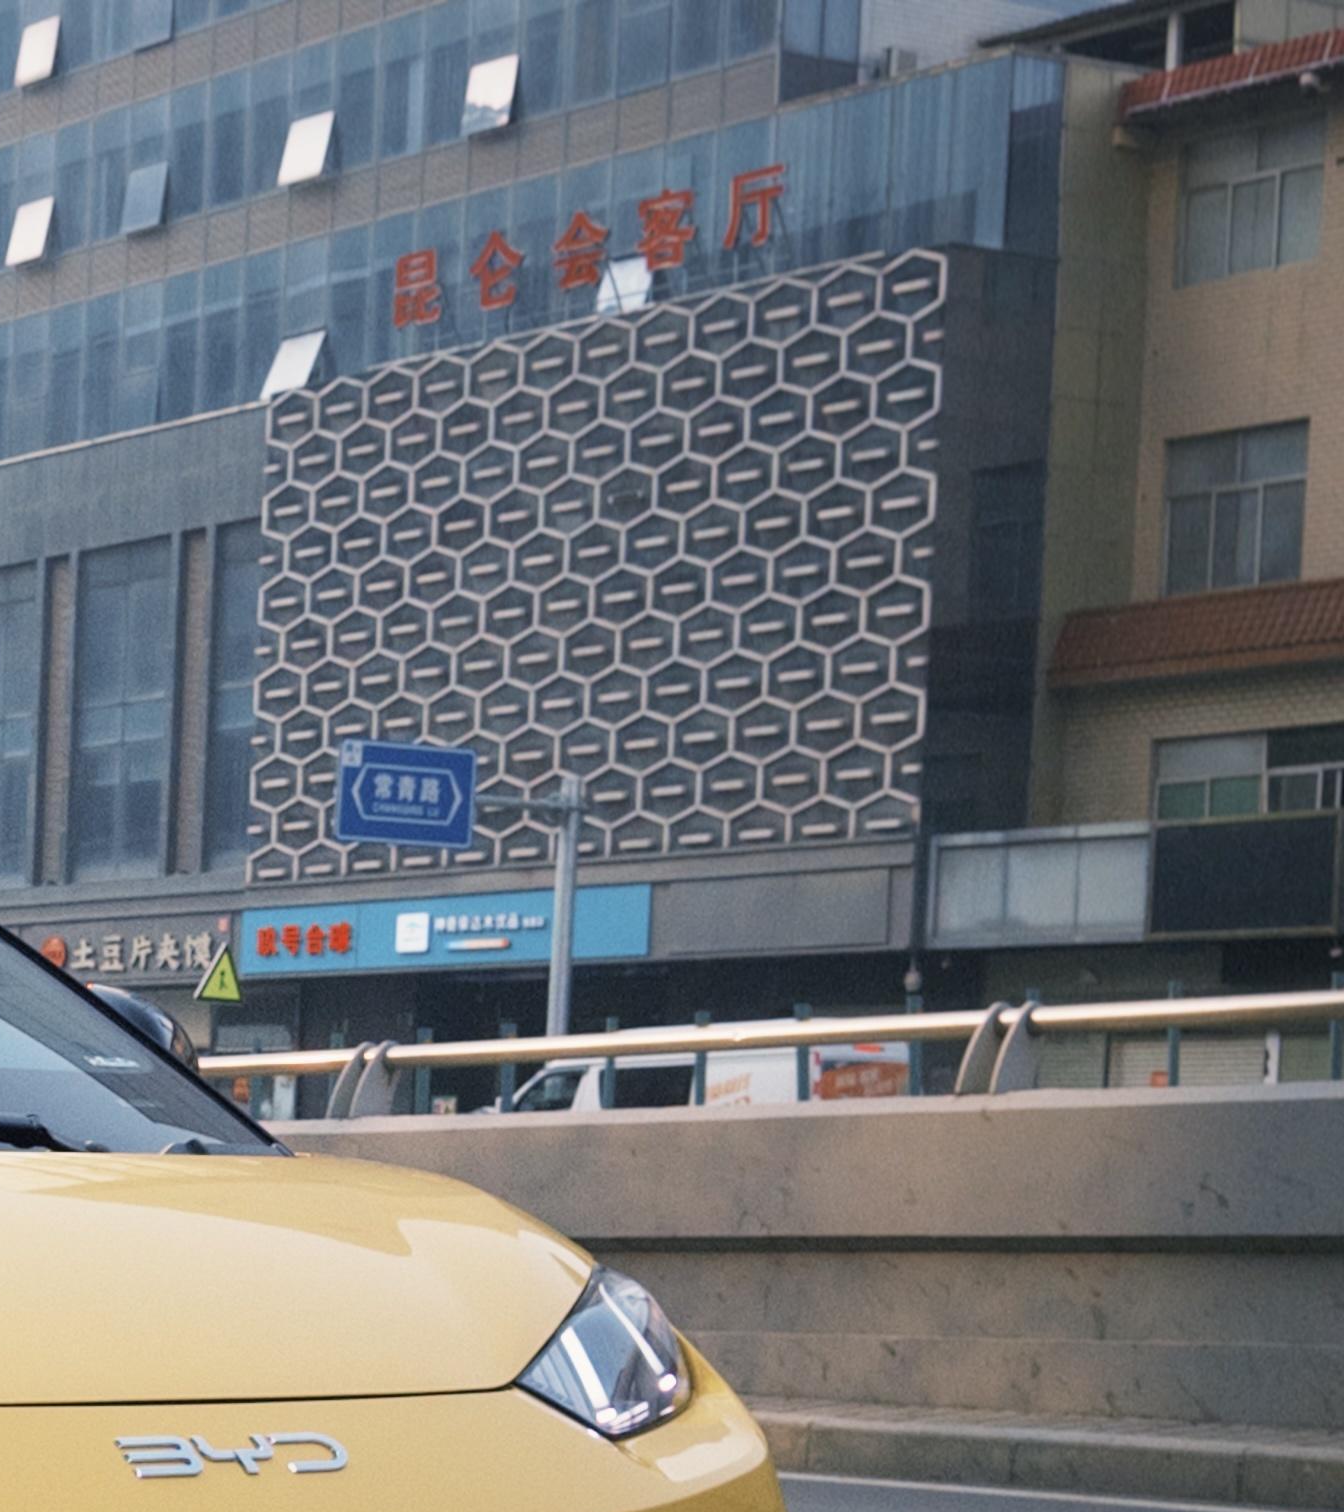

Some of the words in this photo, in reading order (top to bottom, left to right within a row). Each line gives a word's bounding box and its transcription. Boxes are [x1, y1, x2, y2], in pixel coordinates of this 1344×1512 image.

[392, 162, 786, 329] 昆仑会客厅
[373, 772, 441, 804] 常青路
[114, 1431, 348, 1479] BYD
